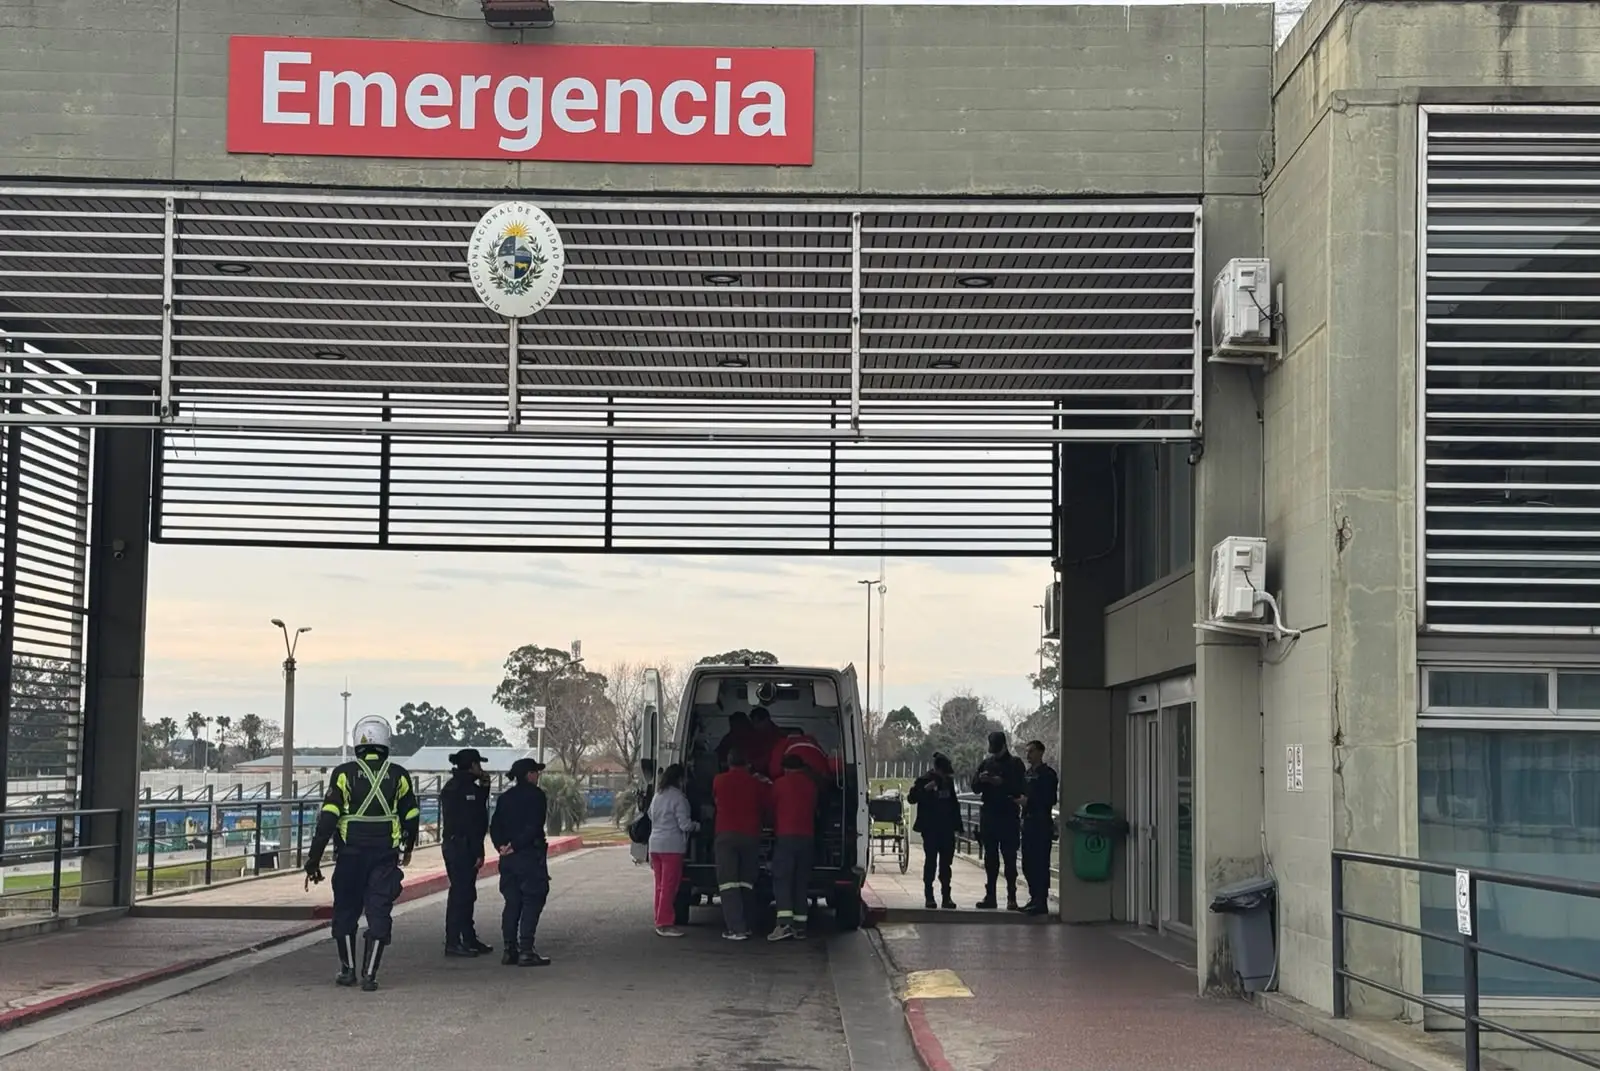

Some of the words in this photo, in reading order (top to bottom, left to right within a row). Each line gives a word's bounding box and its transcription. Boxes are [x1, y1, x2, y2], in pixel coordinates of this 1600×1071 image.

[263, 51, 787, 152] Emergencia
[473, 206, 512, 252] NACIONAL
[517, 206, 532, 215] DE
[534, 214, 560, 260] SANIDAD
[471, 253, 501, 311] DIRECCION
[529, 265, 560, 312] POLICIAL
